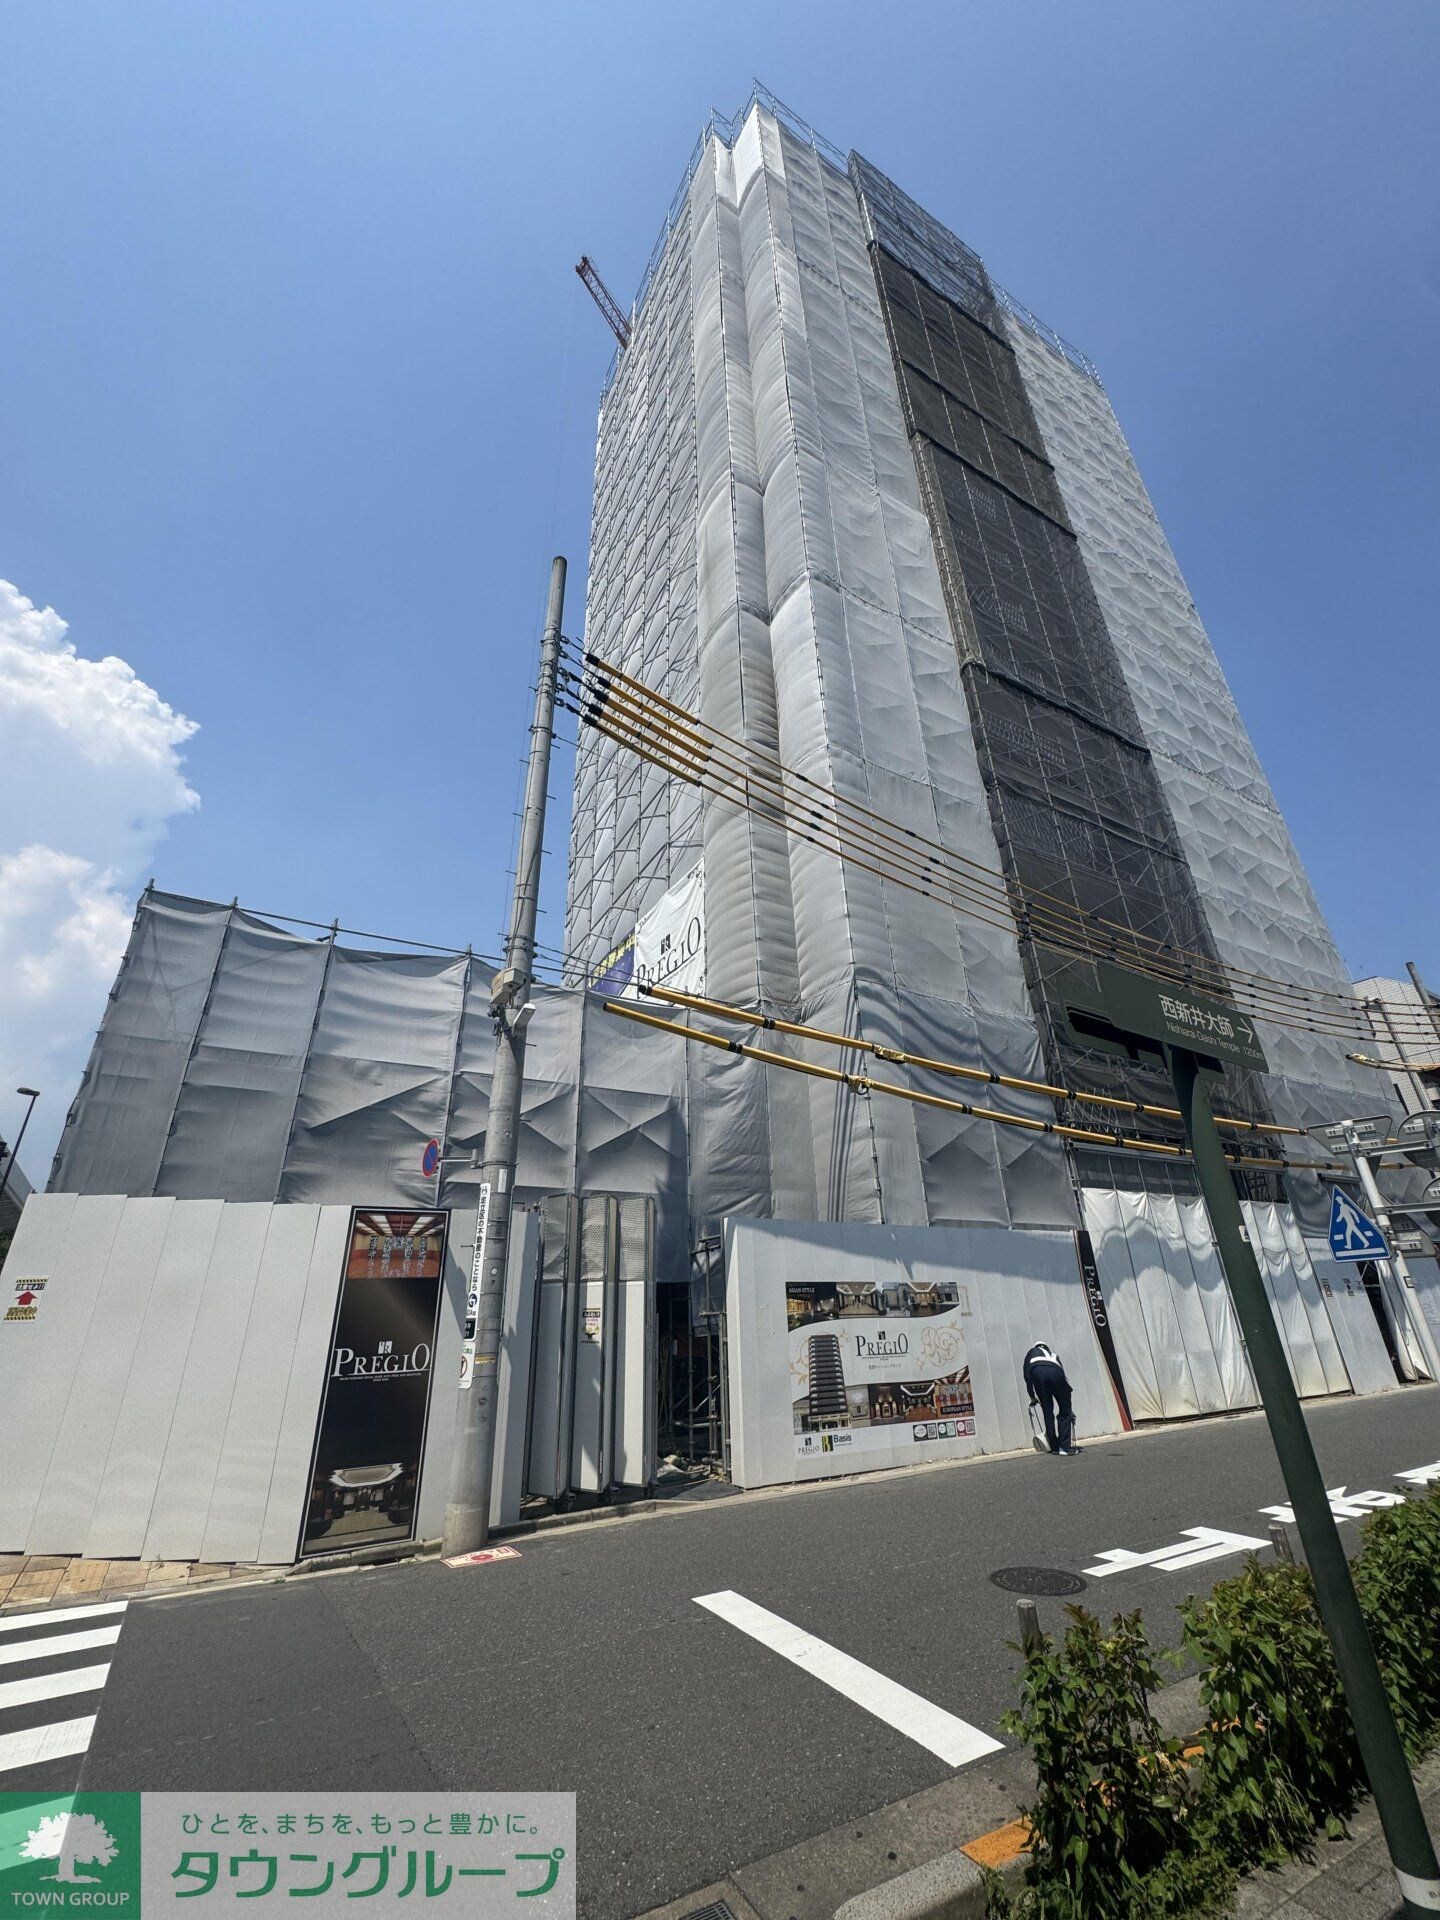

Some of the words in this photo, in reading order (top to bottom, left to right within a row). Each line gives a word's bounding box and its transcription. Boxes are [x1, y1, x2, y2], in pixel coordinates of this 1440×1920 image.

[1158, 993, 1235, 1039] 西新井大師
[1216, 1037, 1241, 1053] Temple
[1084, 1265, 1107, 1327] PREGIO
[331, 1342, 431, 1377] PREGIO
[855, 1332, 909, 1357] PREGIO
[834, 1434, 852, 1443] Basis
